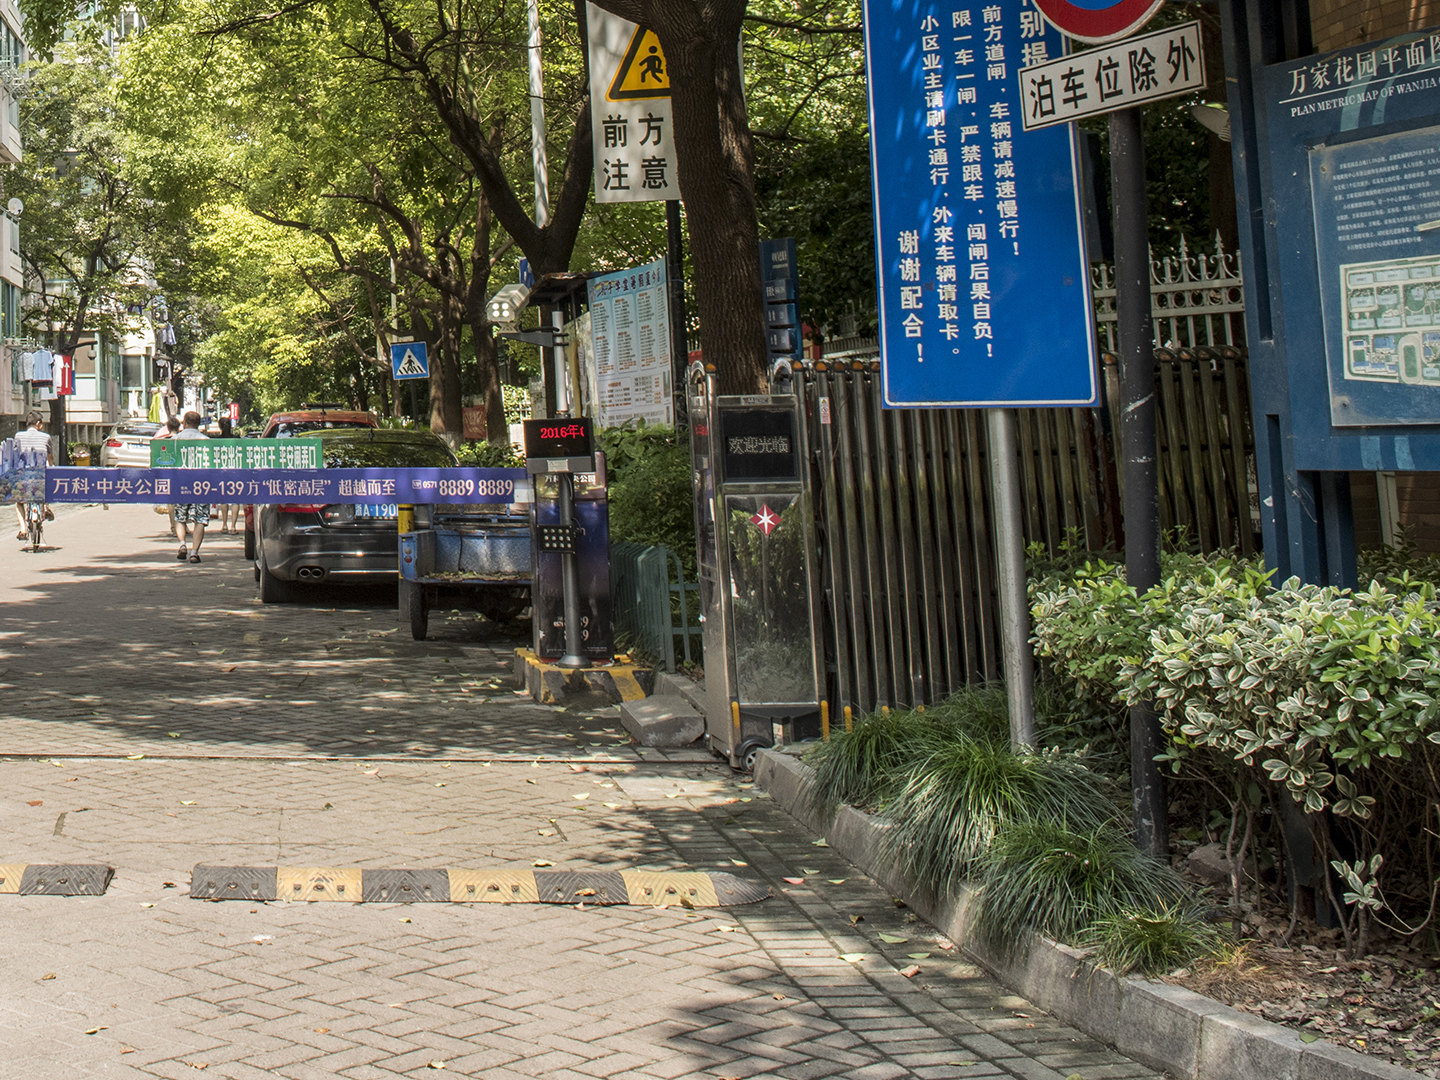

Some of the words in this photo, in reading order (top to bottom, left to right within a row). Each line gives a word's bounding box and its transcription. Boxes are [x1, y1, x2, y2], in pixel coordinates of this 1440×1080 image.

[1030, 35, 1196, 119] 泊车位除外
[1291, 103, 1316, 117] PLAN
[1317, 94, 1356, 112] METRIC
[1357, 89, 1379, 103] MAP
[1380, 86, 1395, 99] OF
[1396, 77, 1437, 95] WANJIA
[602, 112, 665, 149] 前方
[982, 5, 1021, 257] 前方道闸，车辆请减速慢行！
[603, 156, 668, 190] 注意
[920, 15, 961, 356] 小区业主请刷卡通行，外来车辆请取卡。
[952, 10, 994, 358] 限一车一闸，严禁跟车，闯闸后果自负！
[898, 230, 925, 363] 谢谢配合！
[180, 446, 210, 468] 文明行车
[213, 446, 242, 468] 平安出行
[246, 446, 276, 468] 平安江干
[728, 436, 789, 454] 欢迎光临
[52, 477, 171, 495] 万科·中央公园
[339, 478, 396, 496] 超越而至
[423, 481, 437, 489] 0571
[439, 479, 474, 496] 8889
[478, 479, 513, 496] 8889
